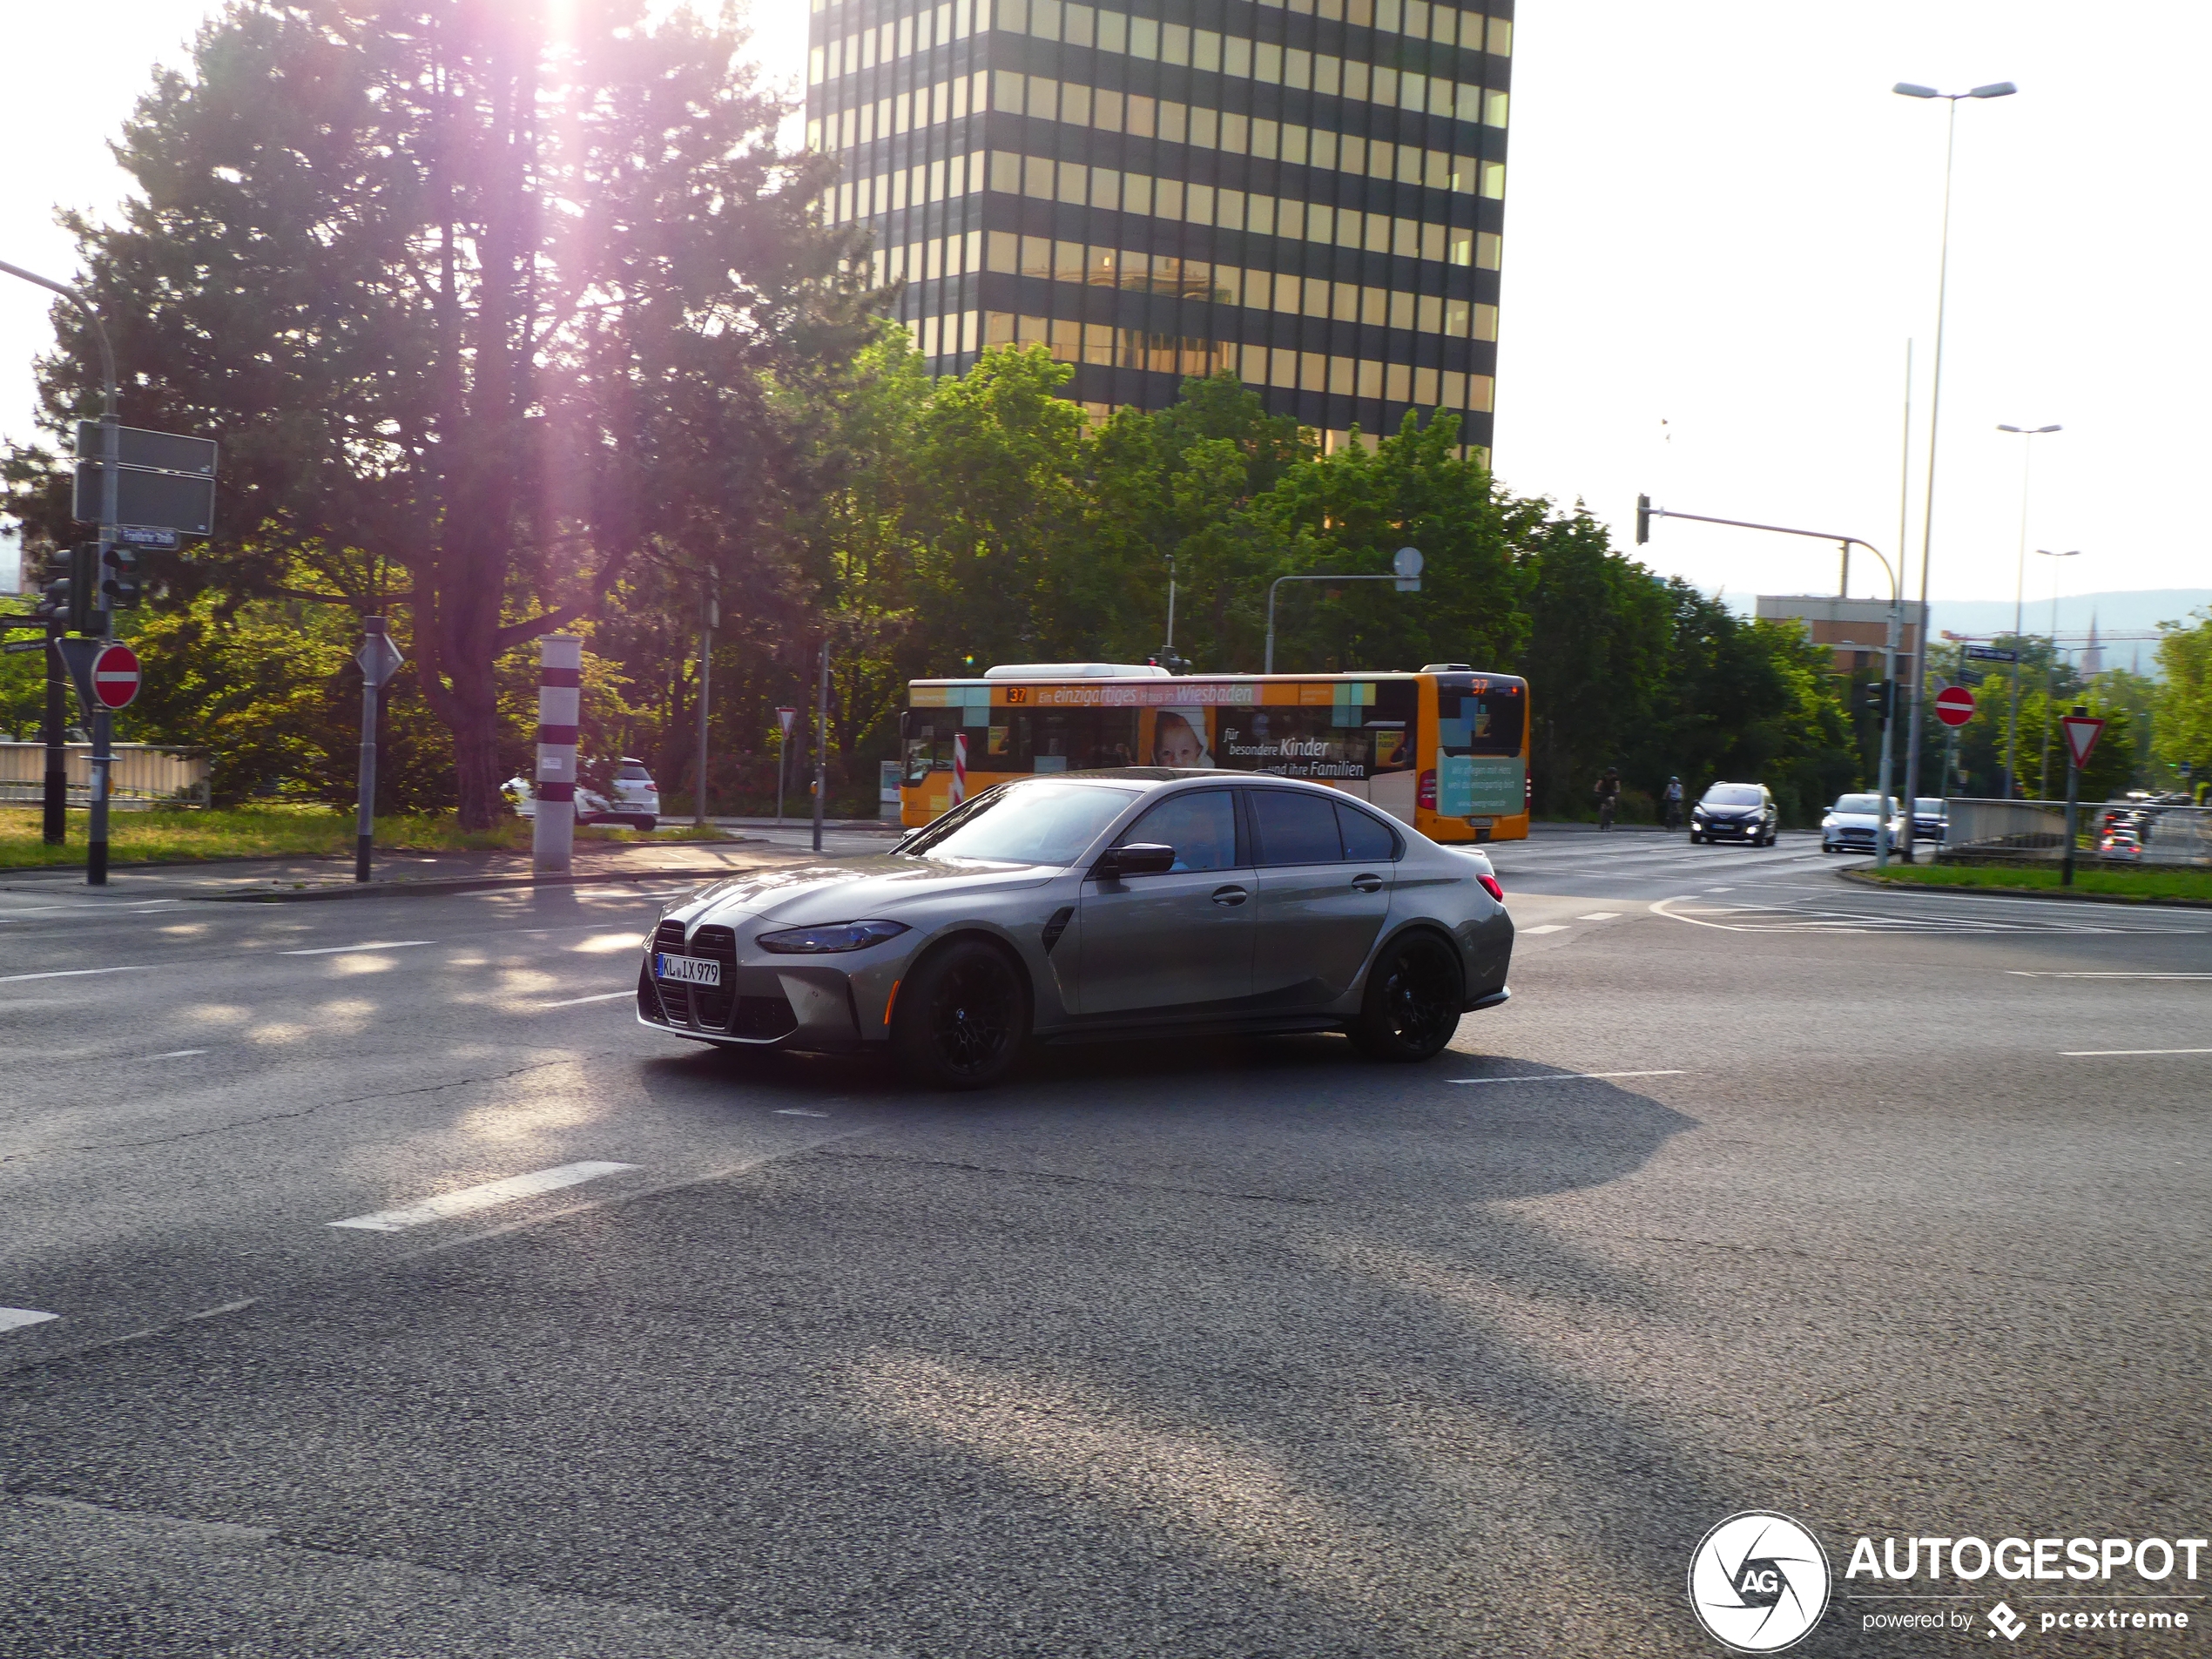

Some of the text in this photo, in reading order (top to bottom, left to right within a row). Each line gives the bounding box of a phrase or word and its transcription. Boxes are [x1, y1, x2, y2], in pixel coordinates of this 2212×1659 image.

[1472, 678, 1488, 694] 37
[1010, 688, 1027, 702] 37
[1038, 691, 1052, 704] Ein
[1054, 685, 1137, 706] einzigartiges
[1177, 685, 1252, 703] Wiesbaden
[1223, 727, 1239, 743] für
[1229, 737, 1329, 757] besondere Kinder
[1289, 763, 1308, 775] ihre
[1310, 760, 1365, 777] Familien
[664, 957, 718, 982] KL IX 979
